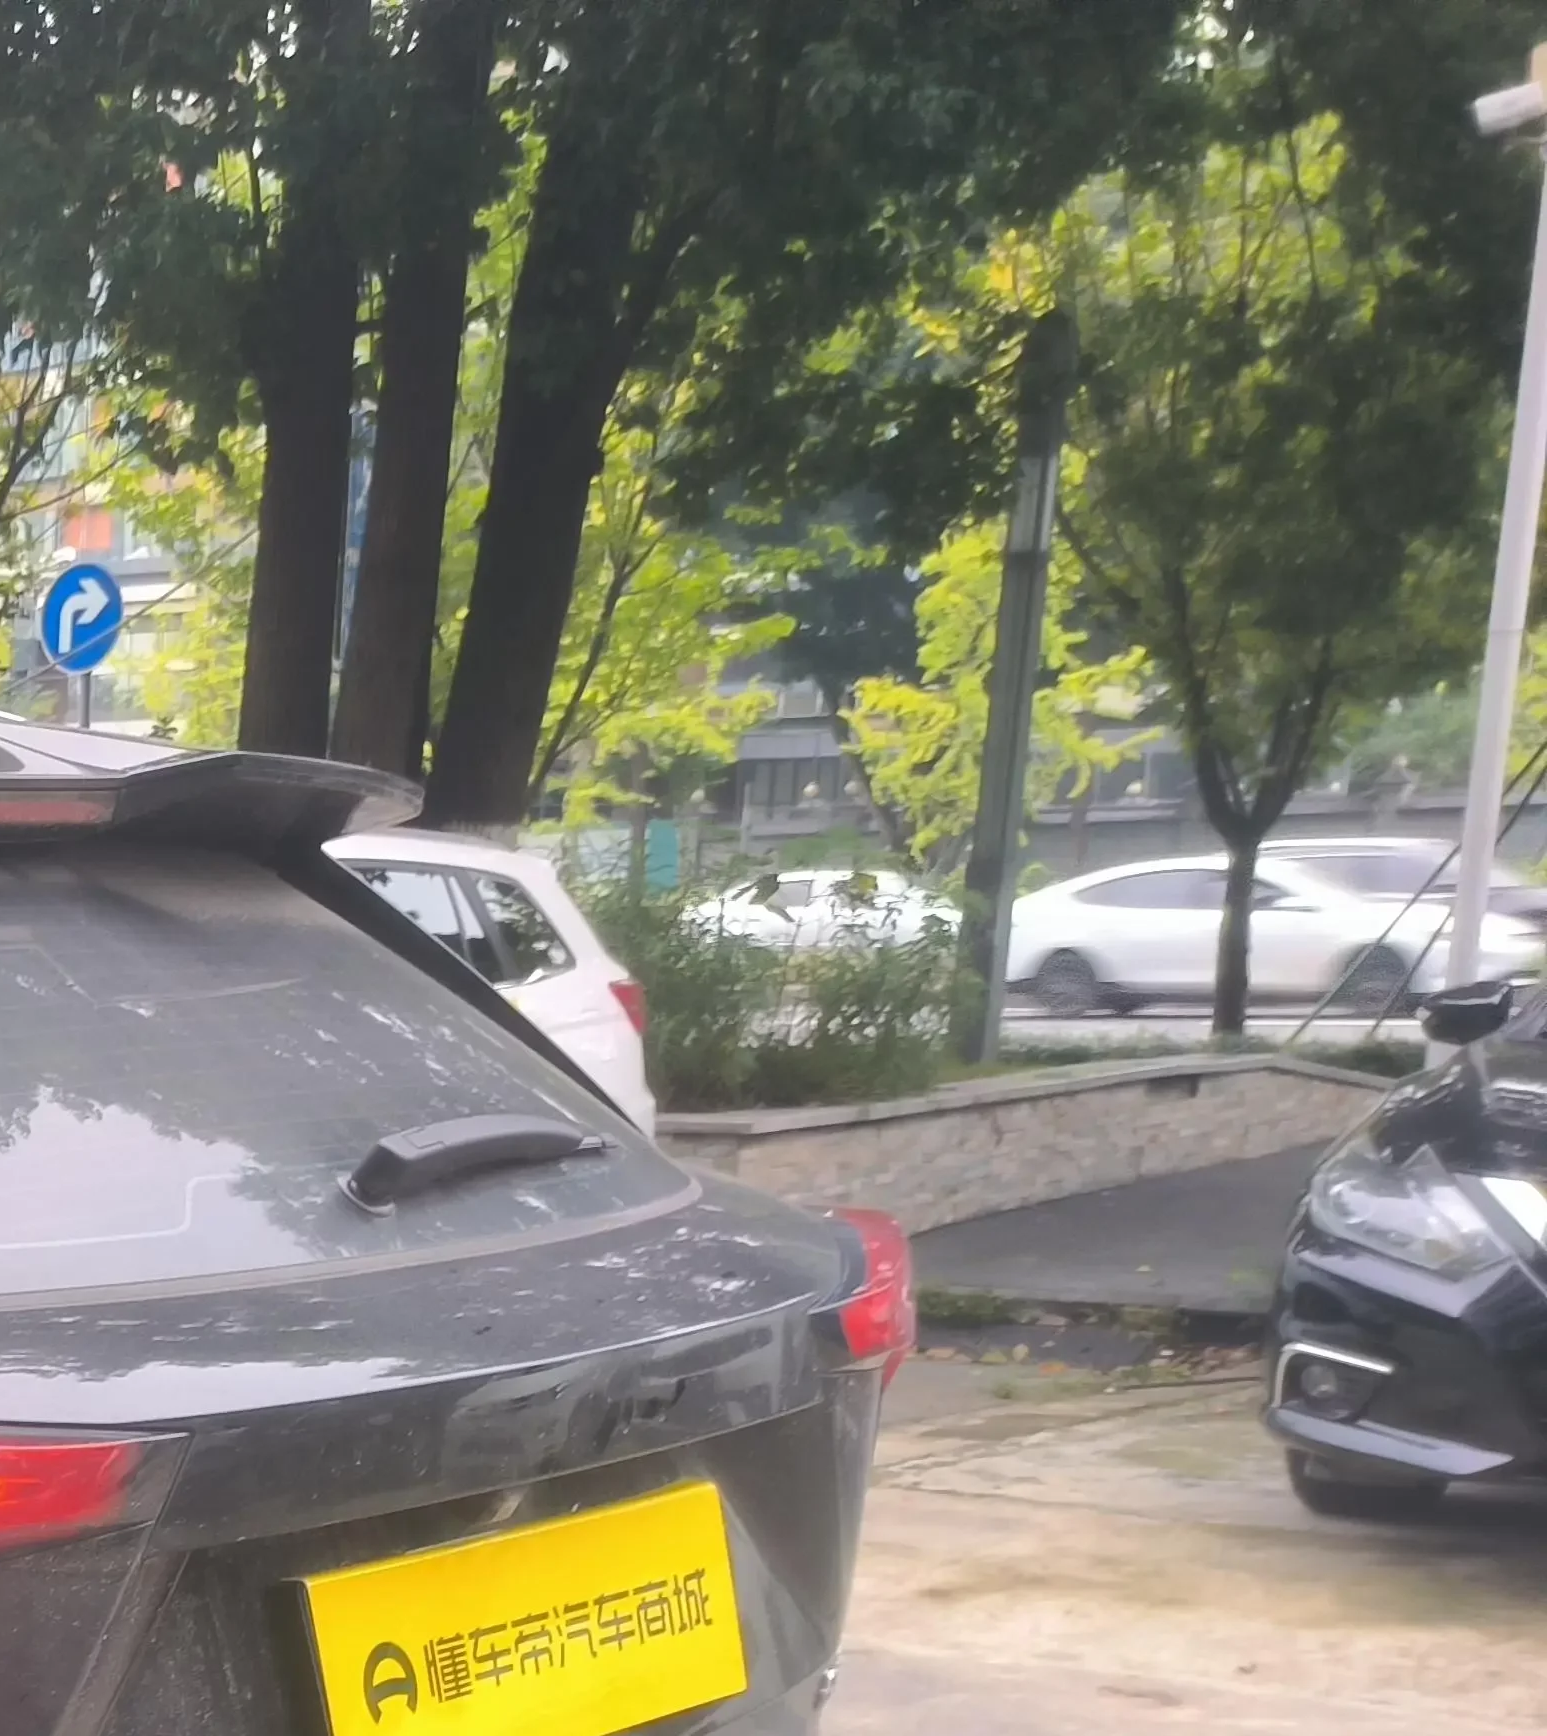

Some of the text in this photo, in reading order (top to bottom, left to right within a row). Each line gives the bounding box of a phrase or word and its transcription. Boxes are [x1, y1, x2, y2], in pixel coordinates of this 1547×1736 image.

[422, 1567, 713, 1703] 懂车帝汽车商城
